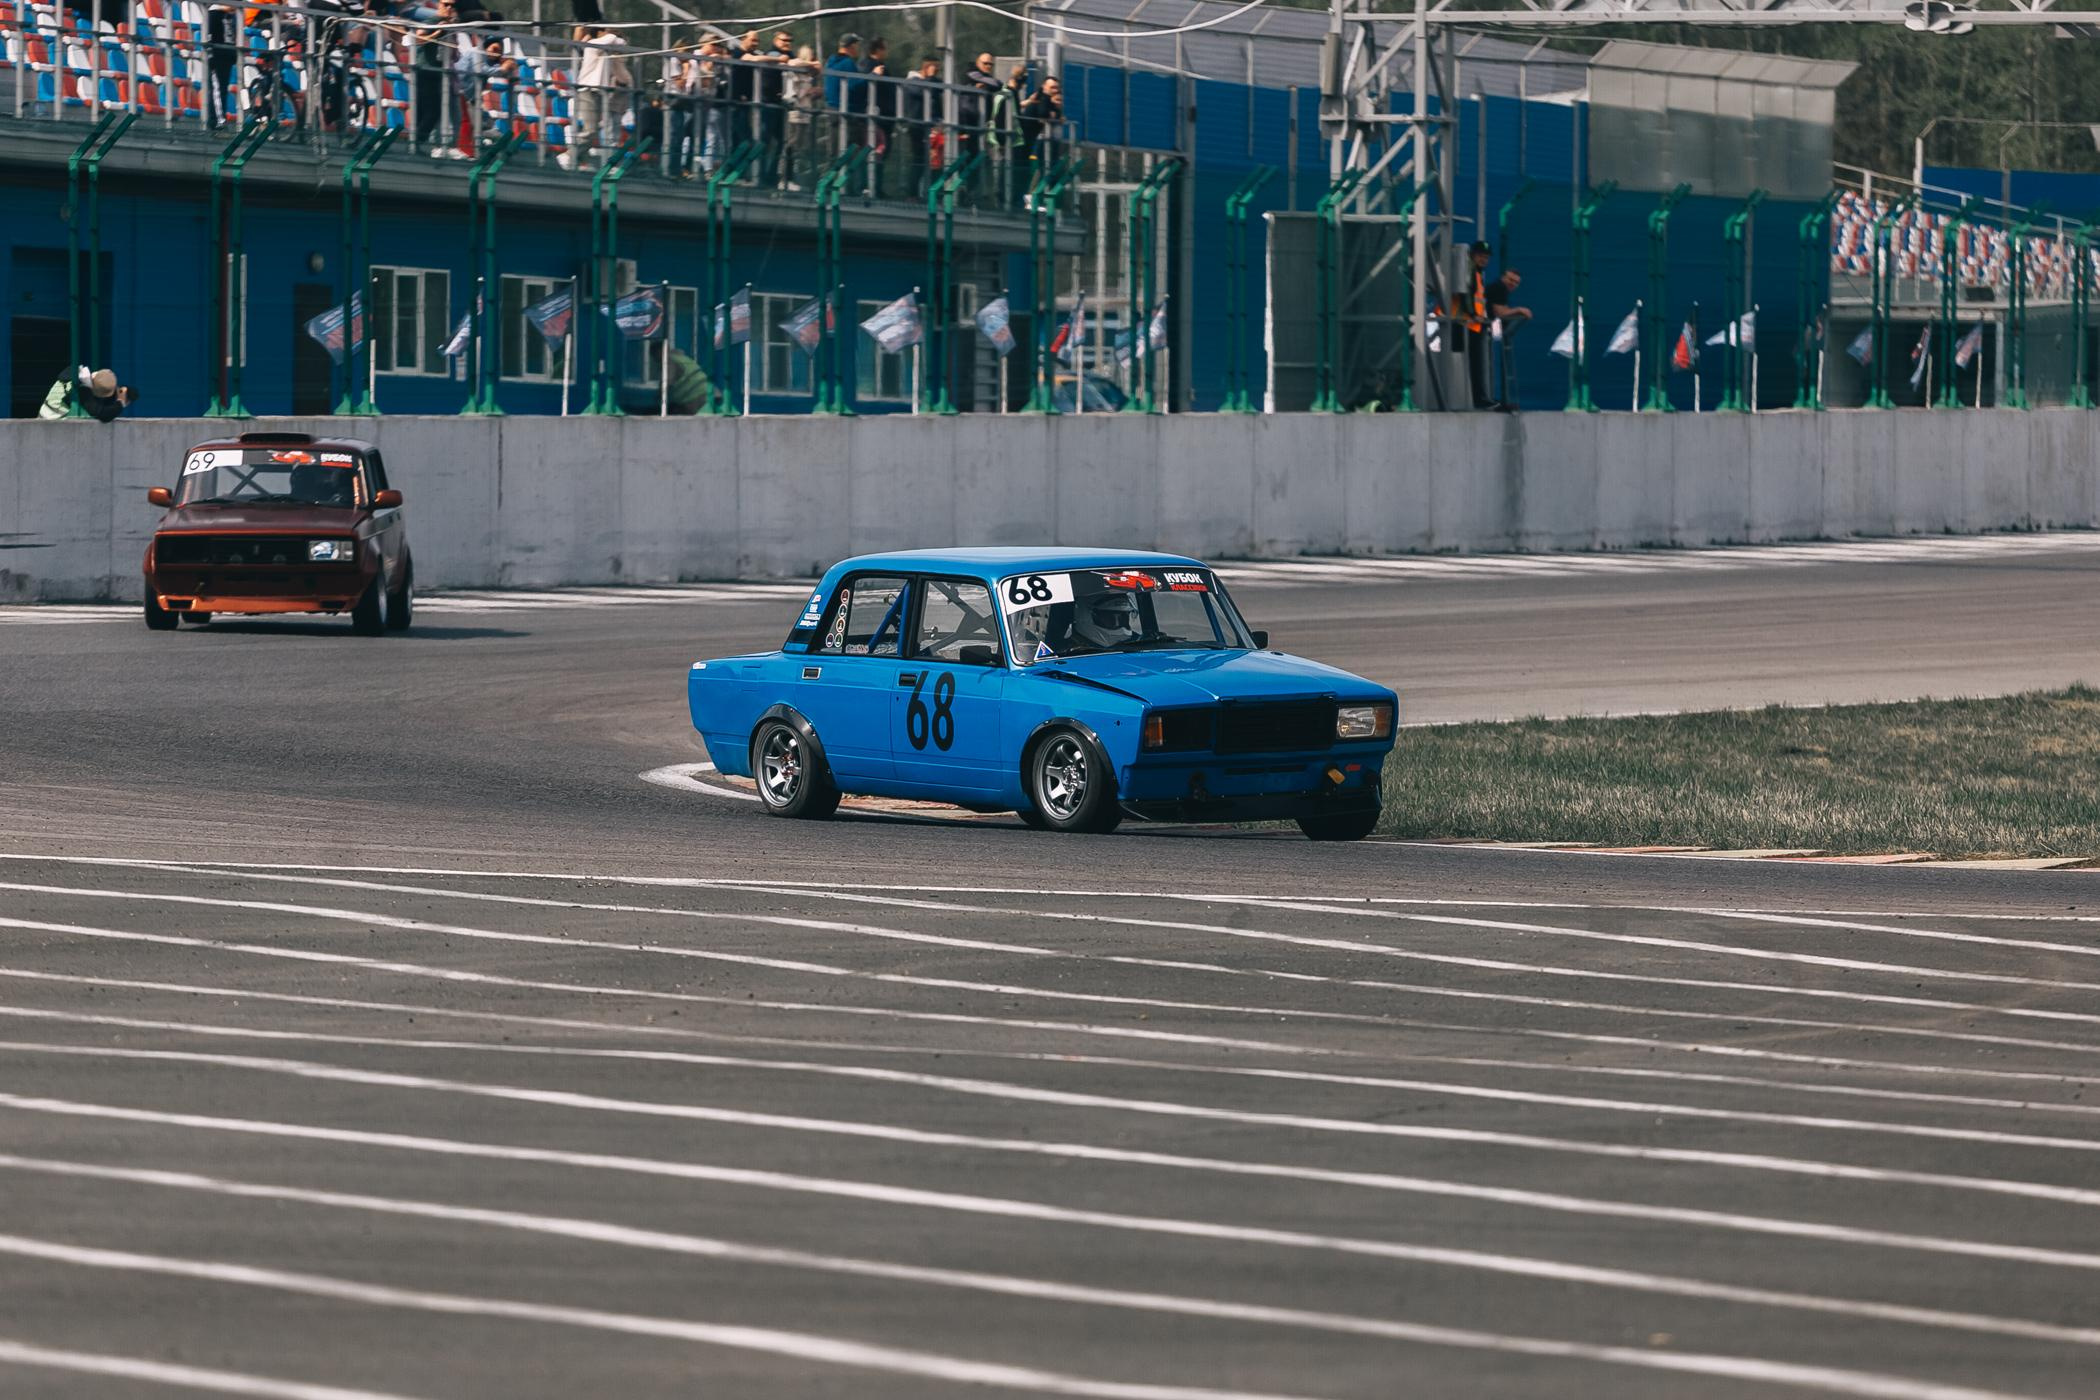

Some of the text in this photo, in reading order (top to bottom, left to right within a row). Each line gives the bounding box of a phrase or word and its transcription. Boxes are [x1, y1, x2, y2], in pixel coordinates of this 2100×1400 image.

[189, 452, 215, 471] 69
[1163, 572, 1204, 584] КУБОК
[1009, 576, 1053, 605] 68
[907, 670, 956, 752] 68
